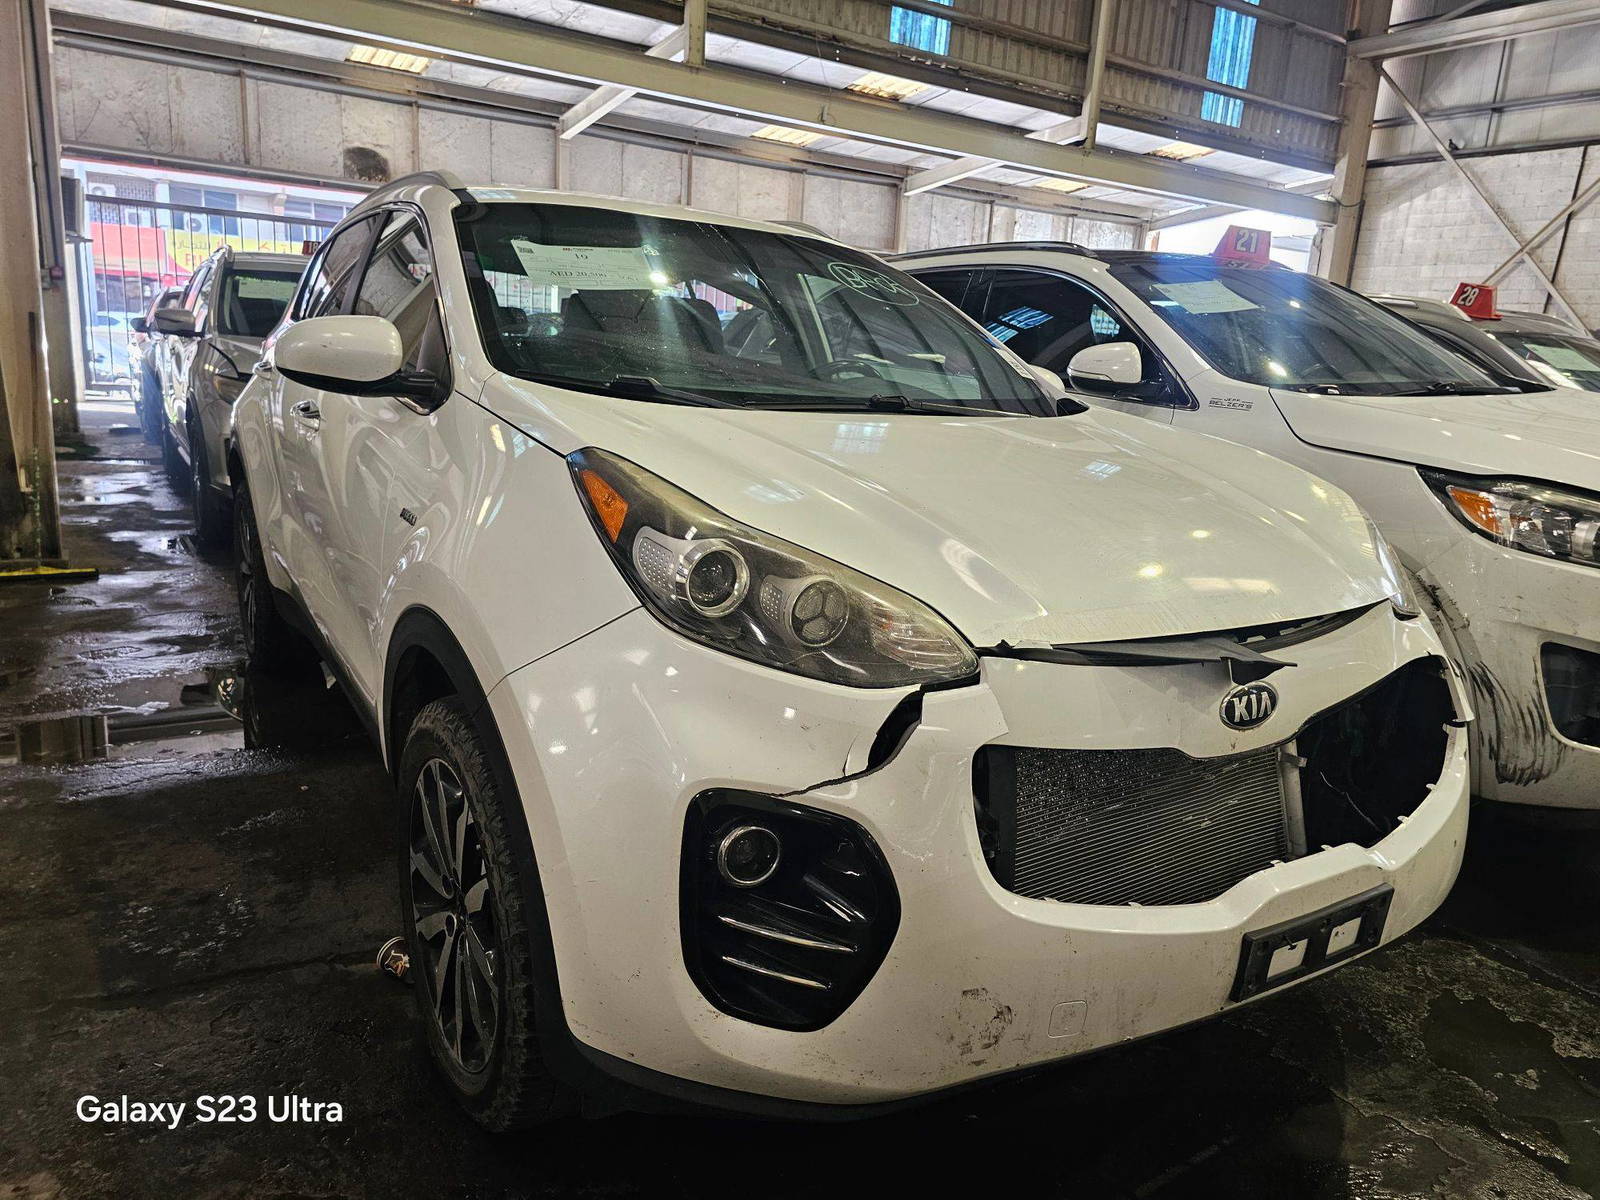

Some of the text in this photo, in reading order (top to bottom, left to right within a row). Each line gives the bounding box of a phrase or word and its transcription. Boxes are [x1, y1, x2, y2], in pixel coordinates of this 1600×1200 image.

[1236, 229, 1257, 253] 21
[1457, 286, 1479, 307] 28
[1230, 691, 1272, 722] KIA
